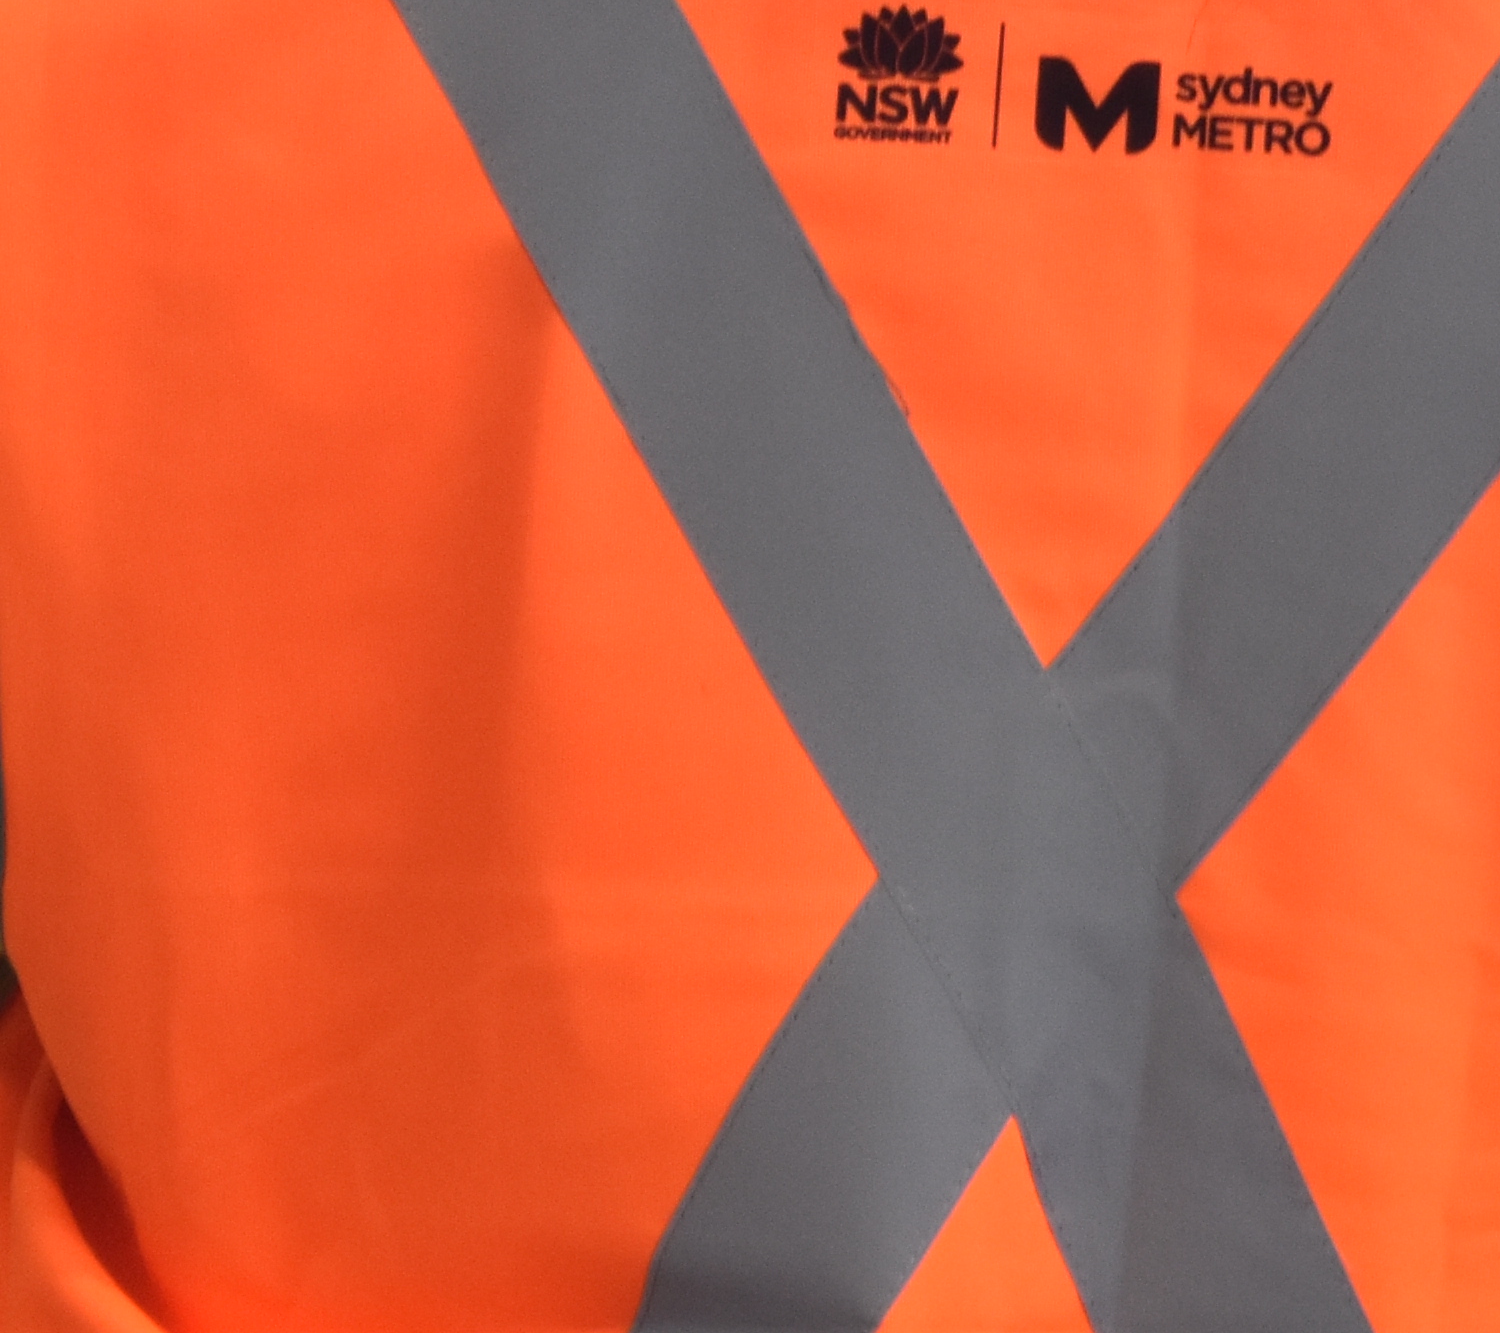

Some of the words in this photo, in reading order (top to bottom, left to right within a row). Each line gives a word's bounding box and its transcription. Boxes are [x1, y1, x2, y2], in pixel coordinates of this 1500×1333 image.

[836, 83, 959, 126] NSW
[1034, 55, 1162, 155] M
[1175, 66, 1333, 116] sydney
[1171, 114, 1332, 157] METRO
